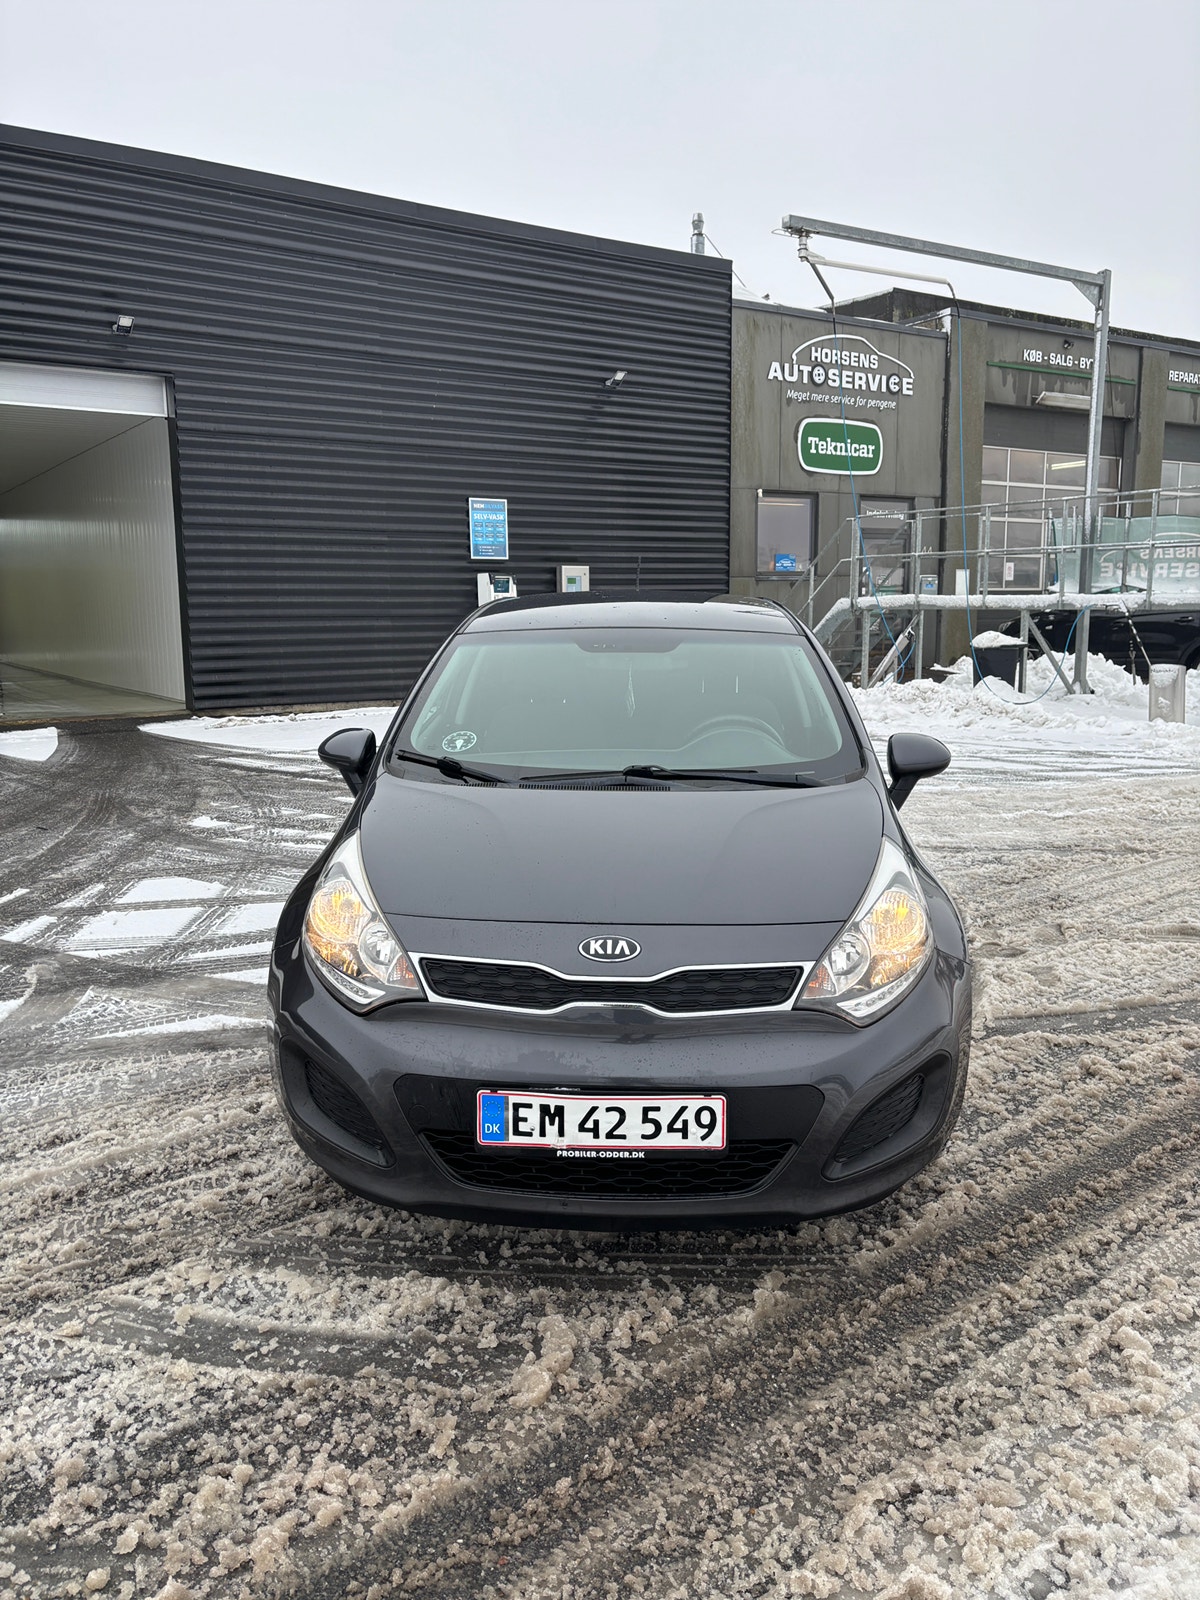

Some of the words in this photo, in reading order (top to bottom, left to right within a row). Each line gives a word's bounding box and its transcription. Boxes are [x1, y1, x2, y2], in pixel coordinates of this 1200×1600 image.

[811, 346, 879, 369] HORSENS
[1023, 349, 1042, 363] KØB
[1049, 352, 1073, 367] SALG
[1080, 357, 1094, 370] BY
[768, 361, 914, 396] AUTOSERVICE
[786, 389, 810, 402] Meget
[811, 393, 830, 402] mere
[830, 394, 855, 405] service
[855, 395, 867, 407] for
[867, 399, 897, 410] pengene
[808, 436, 875, 458] Teknicar
[589, 939, 631, 955] KIA
[484, 1123, 501, 1134] DK
[512, 1102, 565, 1138] EM
[578, 1105, 627, 1140] 42
[640, 1105, 718, 1142] 549
[556, 1150, 645, 1159] PROBILER-ODDER.DK
